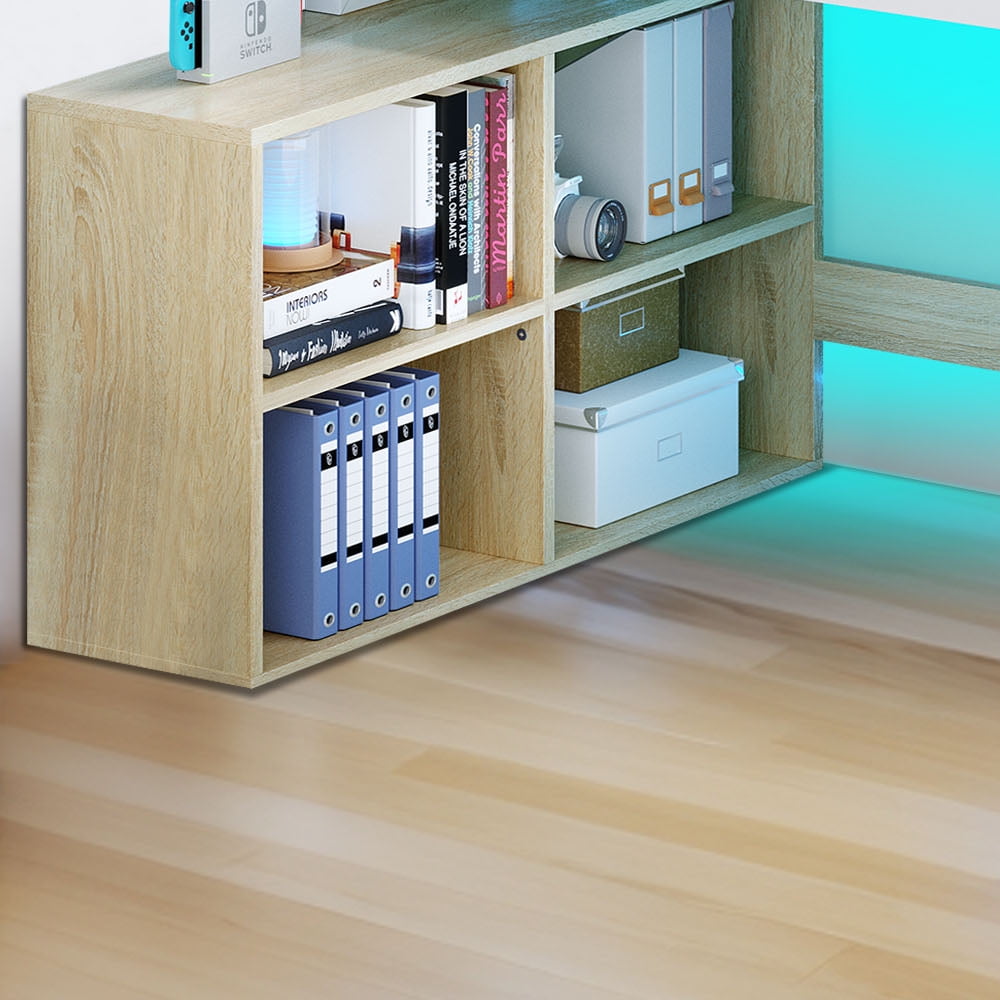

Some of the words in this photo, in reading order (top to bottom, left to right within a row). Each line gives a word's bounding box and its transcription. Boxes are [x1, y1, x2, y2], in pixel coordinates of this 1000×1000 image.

[240, 36, 272, 49] NINTENDO
[240, 43, 272, 60] SWITCH
[492, 92, 507, 162] Parr
[459, 149, 467, 160] IN
[473, 123, 481, 197] Conversations
[448, 162, 457, 202] MICHAEL
[459, 161, 467, 182] THE
[459, 183, 467, 206] SKIN
[459, 207, 467, 222] OF
[473, 198, 481, 221] with
[492, 168, 507, 272] Martin
[448, 202, 457, 250] ONDAATJE
[459, 224, 467, 232] A
[459, 233, 467, 256] LION
[473, 223, 481, 275] Architects
[373, 278, 381, 287] 2
[286, 289, 328, 313] INTERIORS
